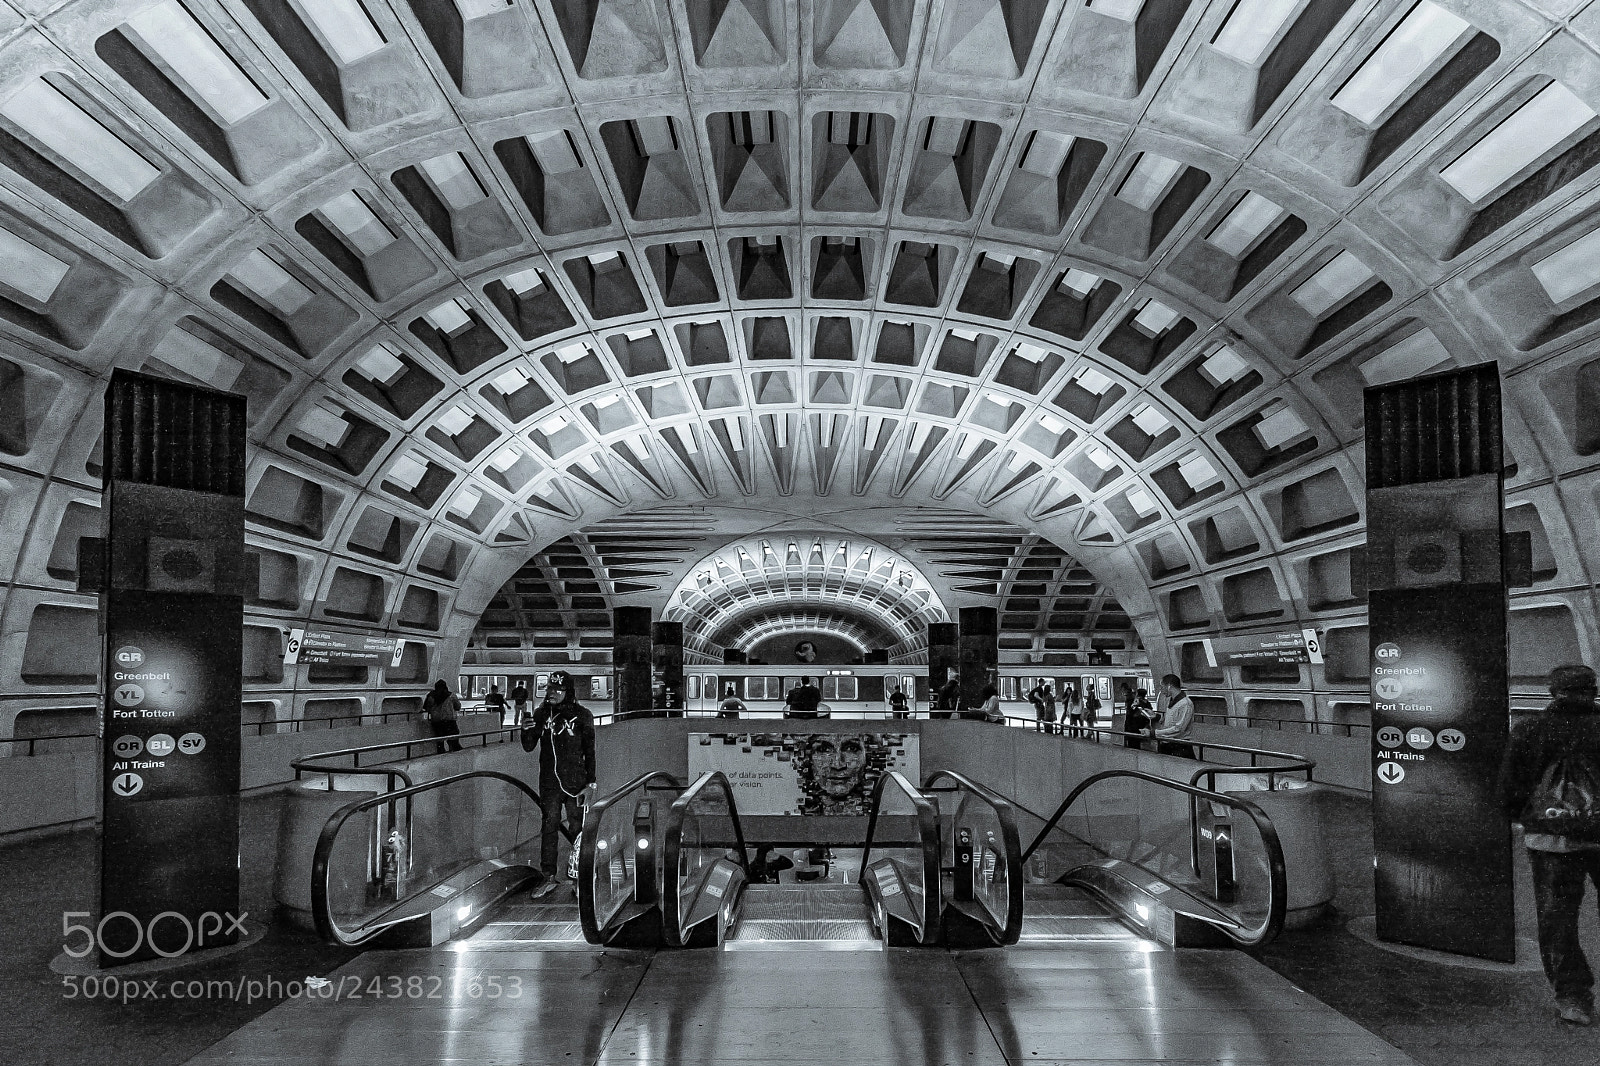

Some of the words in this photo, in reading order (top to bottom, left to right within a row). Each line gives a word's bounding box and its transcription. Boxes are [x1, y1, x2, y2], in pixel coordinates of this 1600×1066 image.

[118, 652, 142, 662] GR
[1377, 648, 1399, 658] GR
[1374, 667, 1426, 675] Greenbelt
[114, 672, 171, 681] Greenbelt
[1380, 684, 1399, 693] YL
[119, 690, 140, 699] YL
[1375, 702, 1397, 711] Fort
[1399, 703, 1433, 712] Totten
[113, 710, 137, 719] Fort
[140, 709, 175, 718] Totten
[1380, 732, 1400, 742] OR
[1410, 733, 1430, 743] BL
[1441, 735, 1461, 744] SV
[117, 742, 140, 751] OR
[150, 740, 171, 750] BL
[182, 738, 202, 748] SV
[1377, 750, 1391, 759] All
[1393, 751, 1425, 761] Trains
[112, 761, 128, 771] All
[130, 760, 165, 769] Trains
[728, 771, 738, 779] of
[739, 771, 757, 779] data
[758, 771, 783, 781] points.
[385, 852, 393, 863] 7
[961, 853, 970, 863] 9
